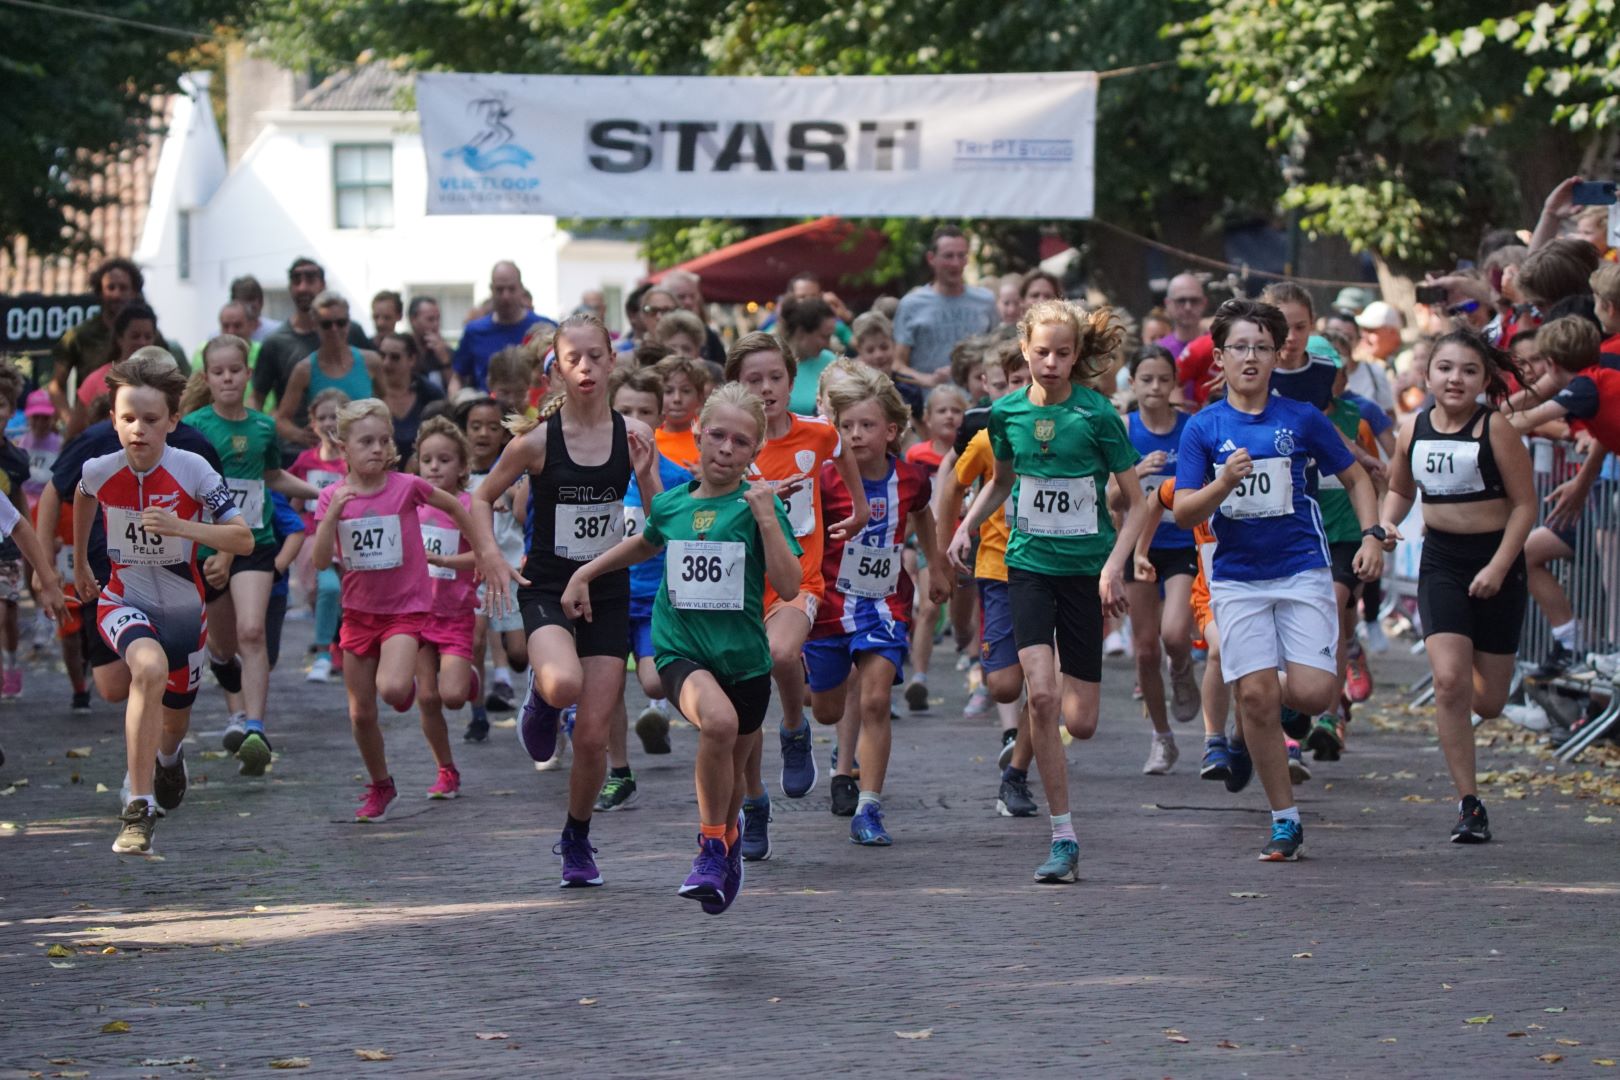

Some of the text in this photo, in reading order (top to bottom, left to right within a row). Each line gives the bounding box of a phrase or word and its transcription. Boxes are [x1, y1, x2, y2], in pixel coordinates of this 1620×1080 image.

[1426, 452, 1454, 474] 571
[230, 489, 248, 509] 77
[559, 486, 618, 502] FILA
[1033, 490, 1070, 513] 478
[574, 514, 611, 539] 387
[622, 519, 638, 538] 2
[132, 544, 165, 555] PELLE
[351, 528, 384, 551] 247
[424, 538, 442, 556] 48
[681, 555, 722, 583] 386
[857, 556, 891, 579] 548
[109, 612, 147, 642] 190
